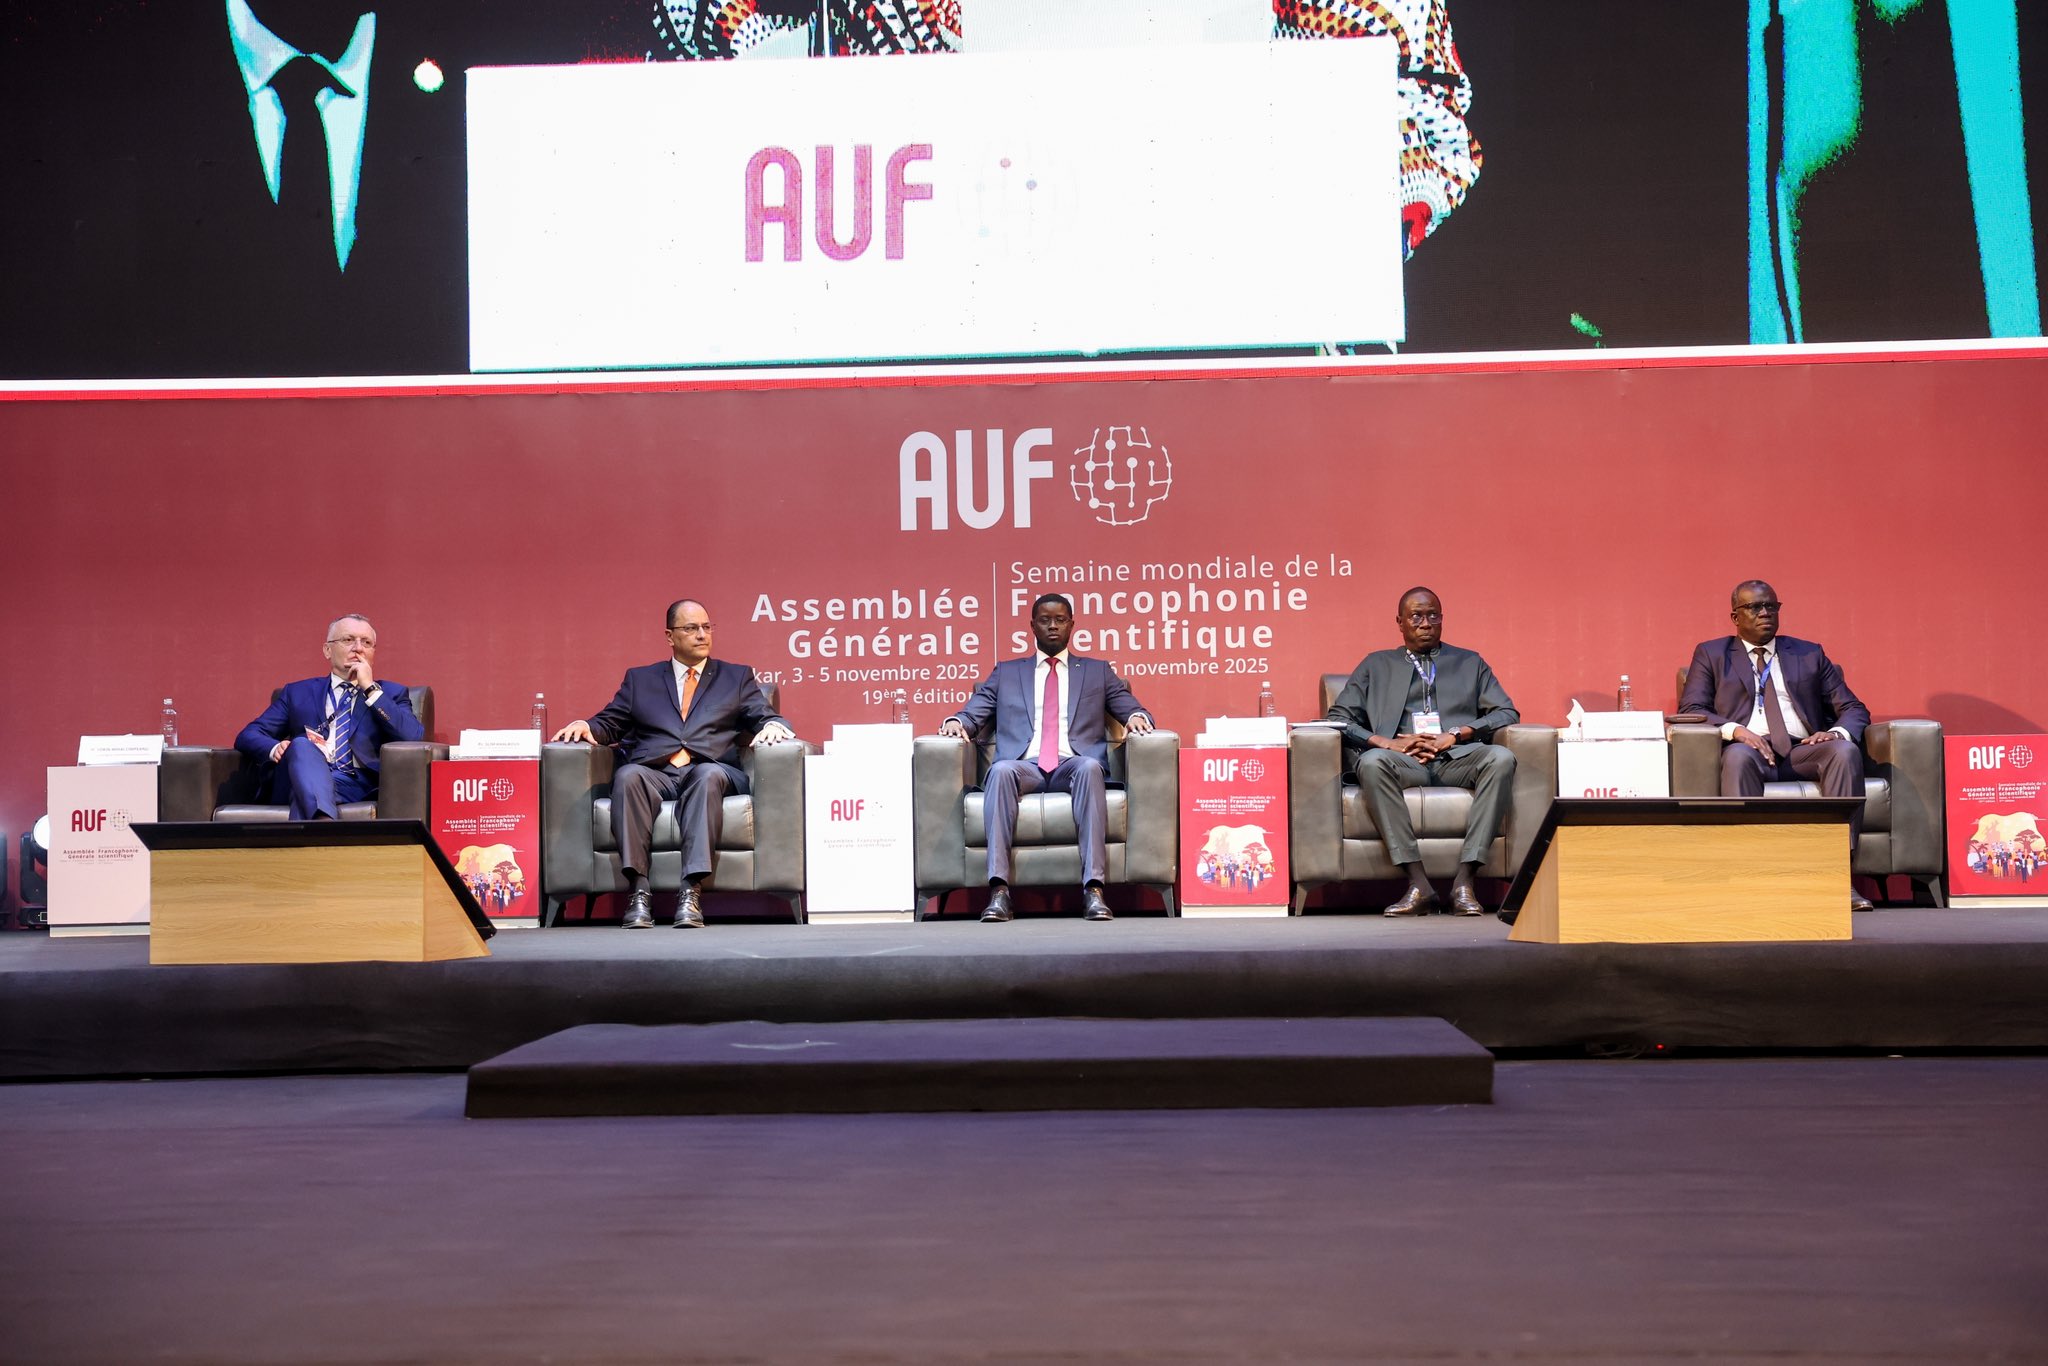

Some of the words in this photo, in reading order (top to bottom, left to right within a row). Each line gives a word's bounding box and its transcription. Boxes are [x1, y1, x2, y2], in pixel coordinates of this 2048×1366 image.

[744, 144, 934, 263] AUF
[899, 428, 1053, 530] AUF
[1011, 560, 1130, 584] Semaine
[1142, 555, 1274, 580] mondiale
[1285, 554, 1319, 577] de
[1330, 553, 1353, 576] la
[751, 588, 979, 622] Assemblée
[1011, 581, 1308, 620] Fncophonie
[788, 625, 980, 658] Générale
[1011, 620, 1273, 657] sentifique
[752, 667, 786, 686] kar,
[792, 667, 803, 683] 3
[820, 667, 830, 682] 5
[836, 665, 931, 682] novembre
[936, 664, 980, 680] 2025
[1124, 659, 1219, 676] novembre
[1224, 658, 1269, 674] 2025
[1203, 759, 1239, 782] AUF
[1968, 746, 2005, 770] AUF
[453, 779, 488, 802] AUF
[72, 809, 106, 832] AUF
[831, 799, 864, 821] AUF
